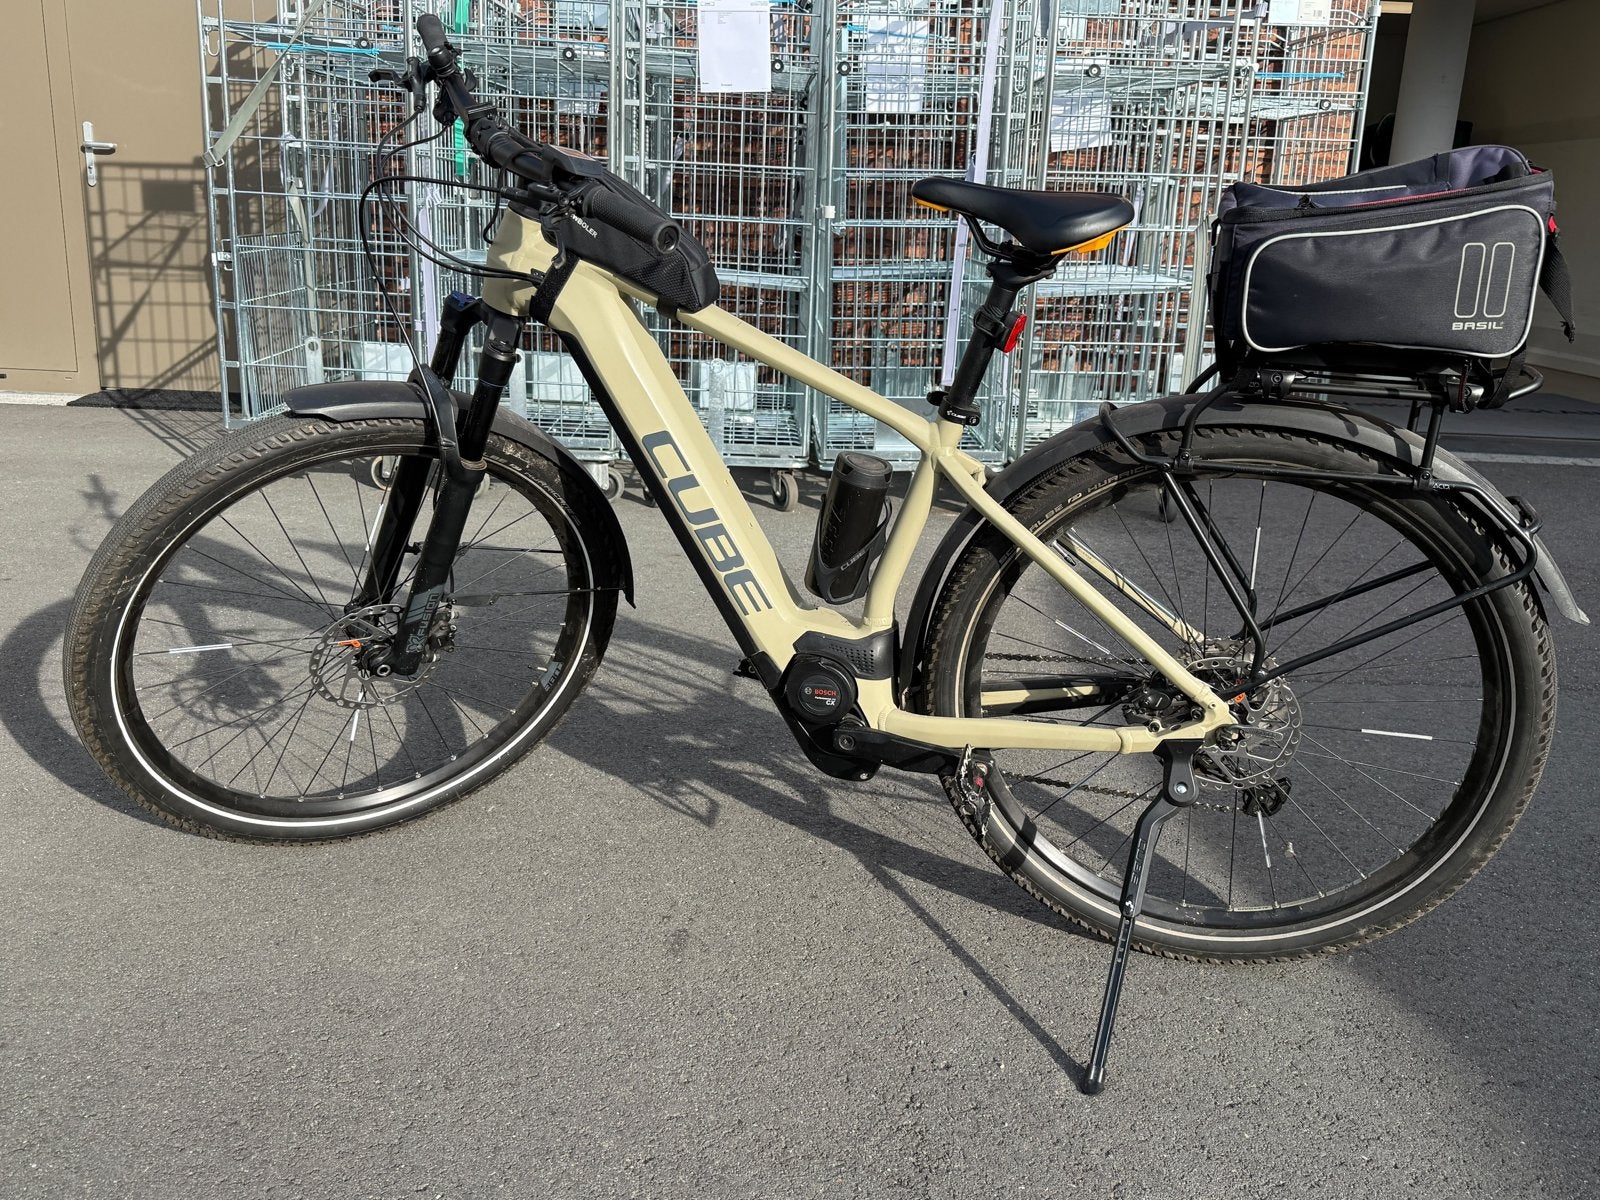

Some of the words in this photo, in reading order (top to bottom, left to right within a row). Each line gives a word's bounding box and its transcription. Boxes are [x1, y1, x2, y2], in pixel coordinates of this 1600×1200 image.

[1452, 321, 1503, 330] BASIL
[642, 430, 773, 616] CUBE
[814, 688, 836, 696] BOSCH
